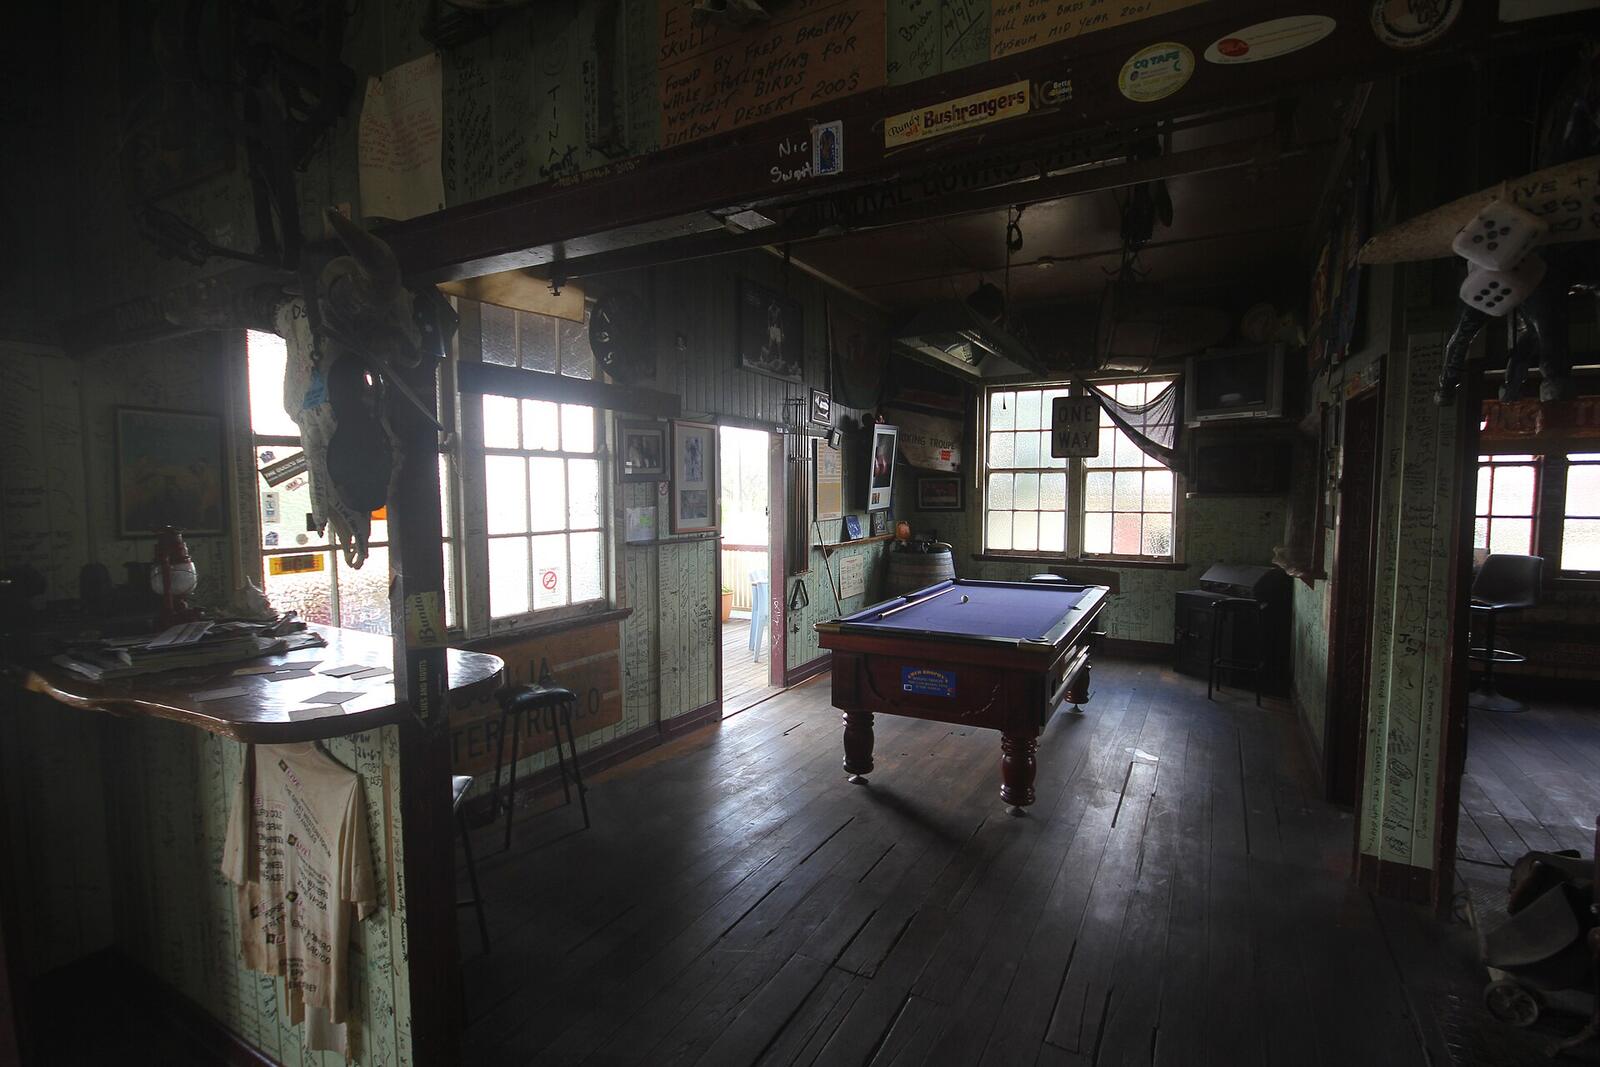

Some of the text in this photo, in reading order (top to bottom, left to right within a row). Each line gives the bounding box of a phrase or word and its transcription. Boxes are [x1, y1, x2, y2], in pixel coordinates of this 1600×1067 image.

[993, 3, 1152, 54] MUSEUM MID YEAR 2001
[994, 18, 1017, 34] WILL
[713, 55, 734, 74] BY
[745, 37, 782, 64] FRED
[754, 71, 806, 99] BIRDS
[664, 86, 703, 110] WHILE
[924, 90, 1026, 129] Bushrangers
[667, 115, 721, 147] SIMPSON
[733, 86, 806, 125] DESERT
[779, 137, 808, 158] Nic
[1059, 406, 1093, 423] ONE
[930, 438, 956, 450] TROUPE
[1059, 430, 1093, 448] WAY
